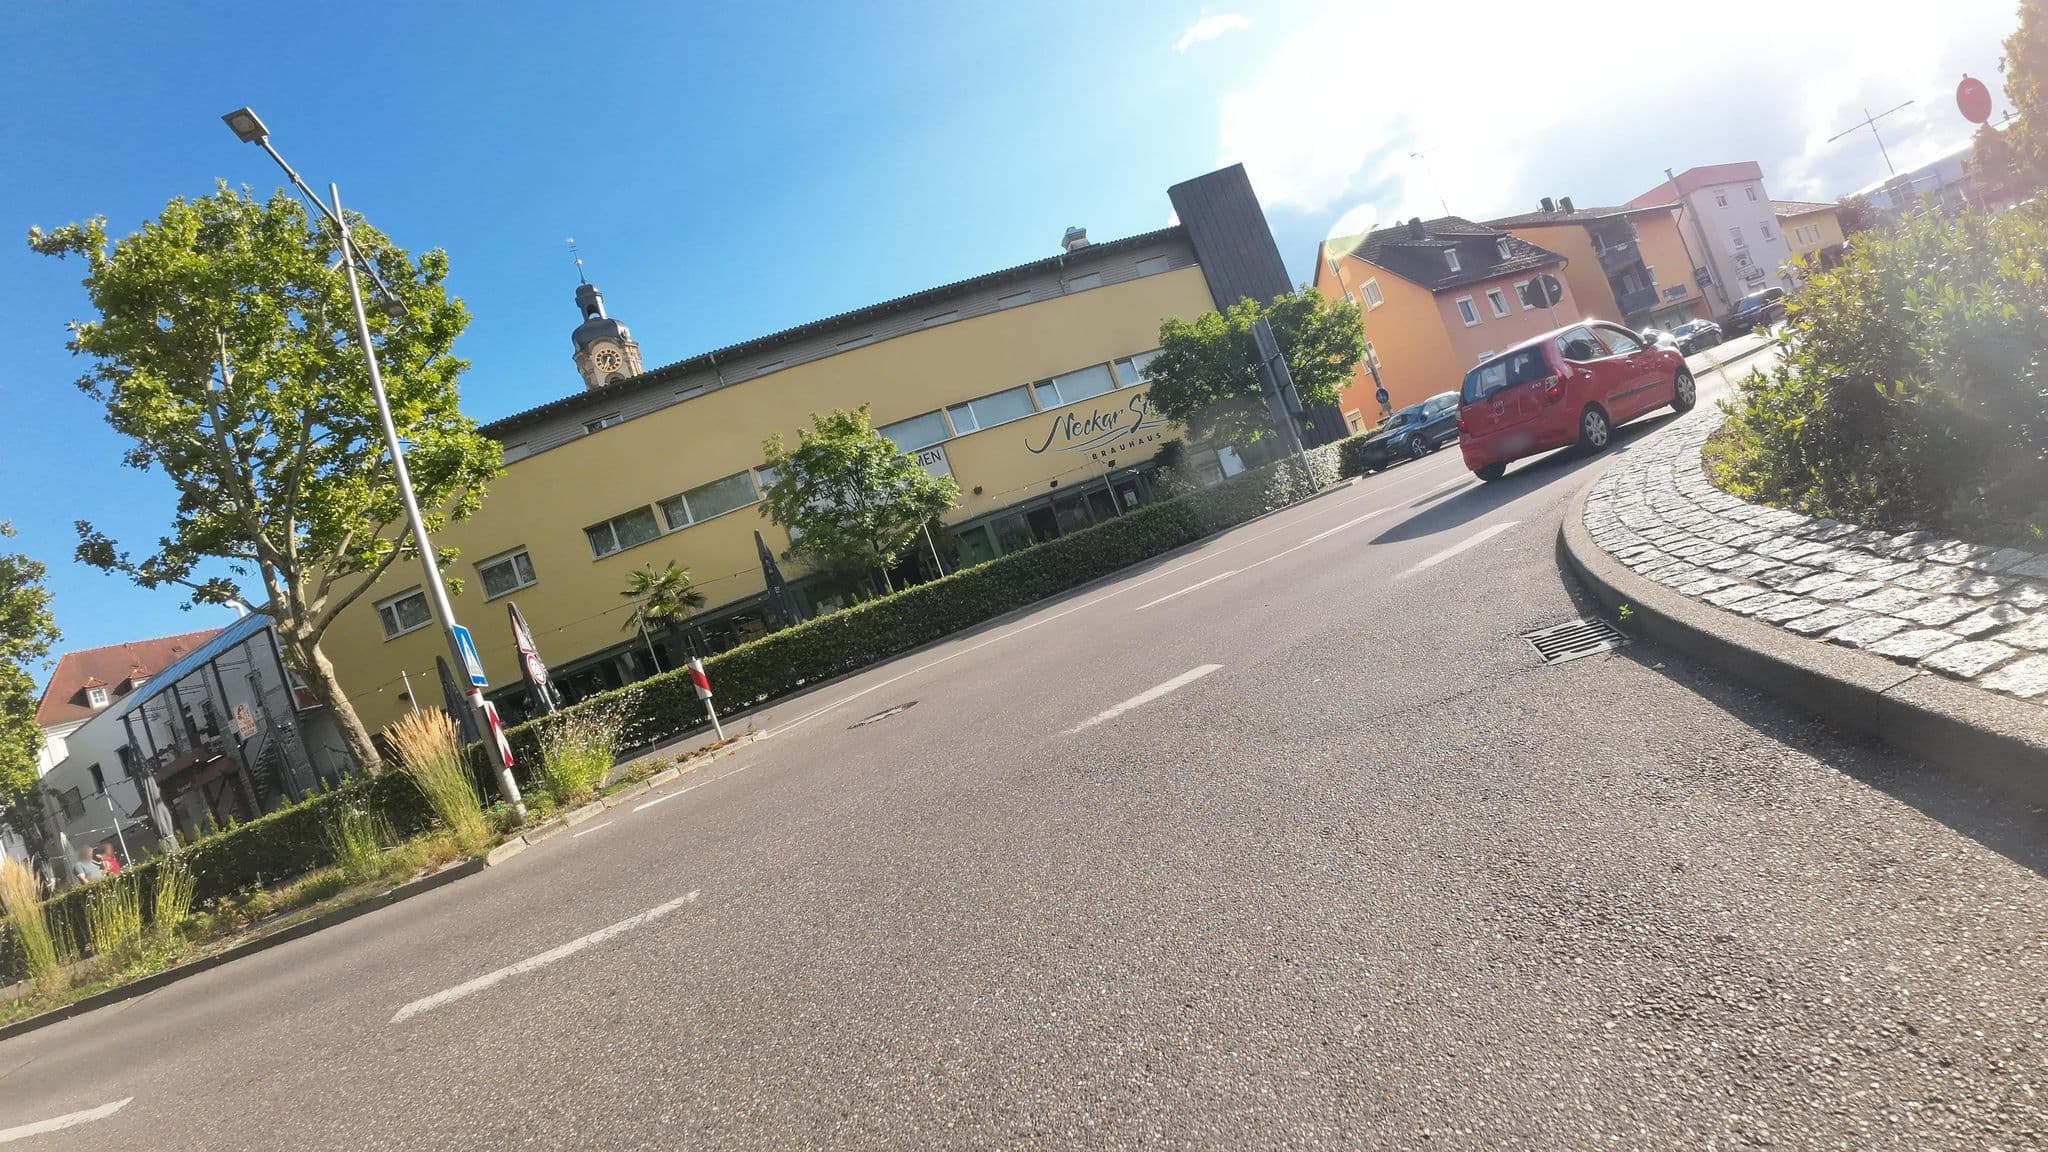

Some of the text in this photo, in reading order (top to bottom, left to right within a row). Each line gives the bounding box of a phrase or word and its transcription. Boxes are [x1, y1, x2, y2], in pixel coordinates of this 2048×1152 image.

[1024, 393, 1152, 454] Neckar St
[1091, 432, 1162, 460] BRAUHAUS
